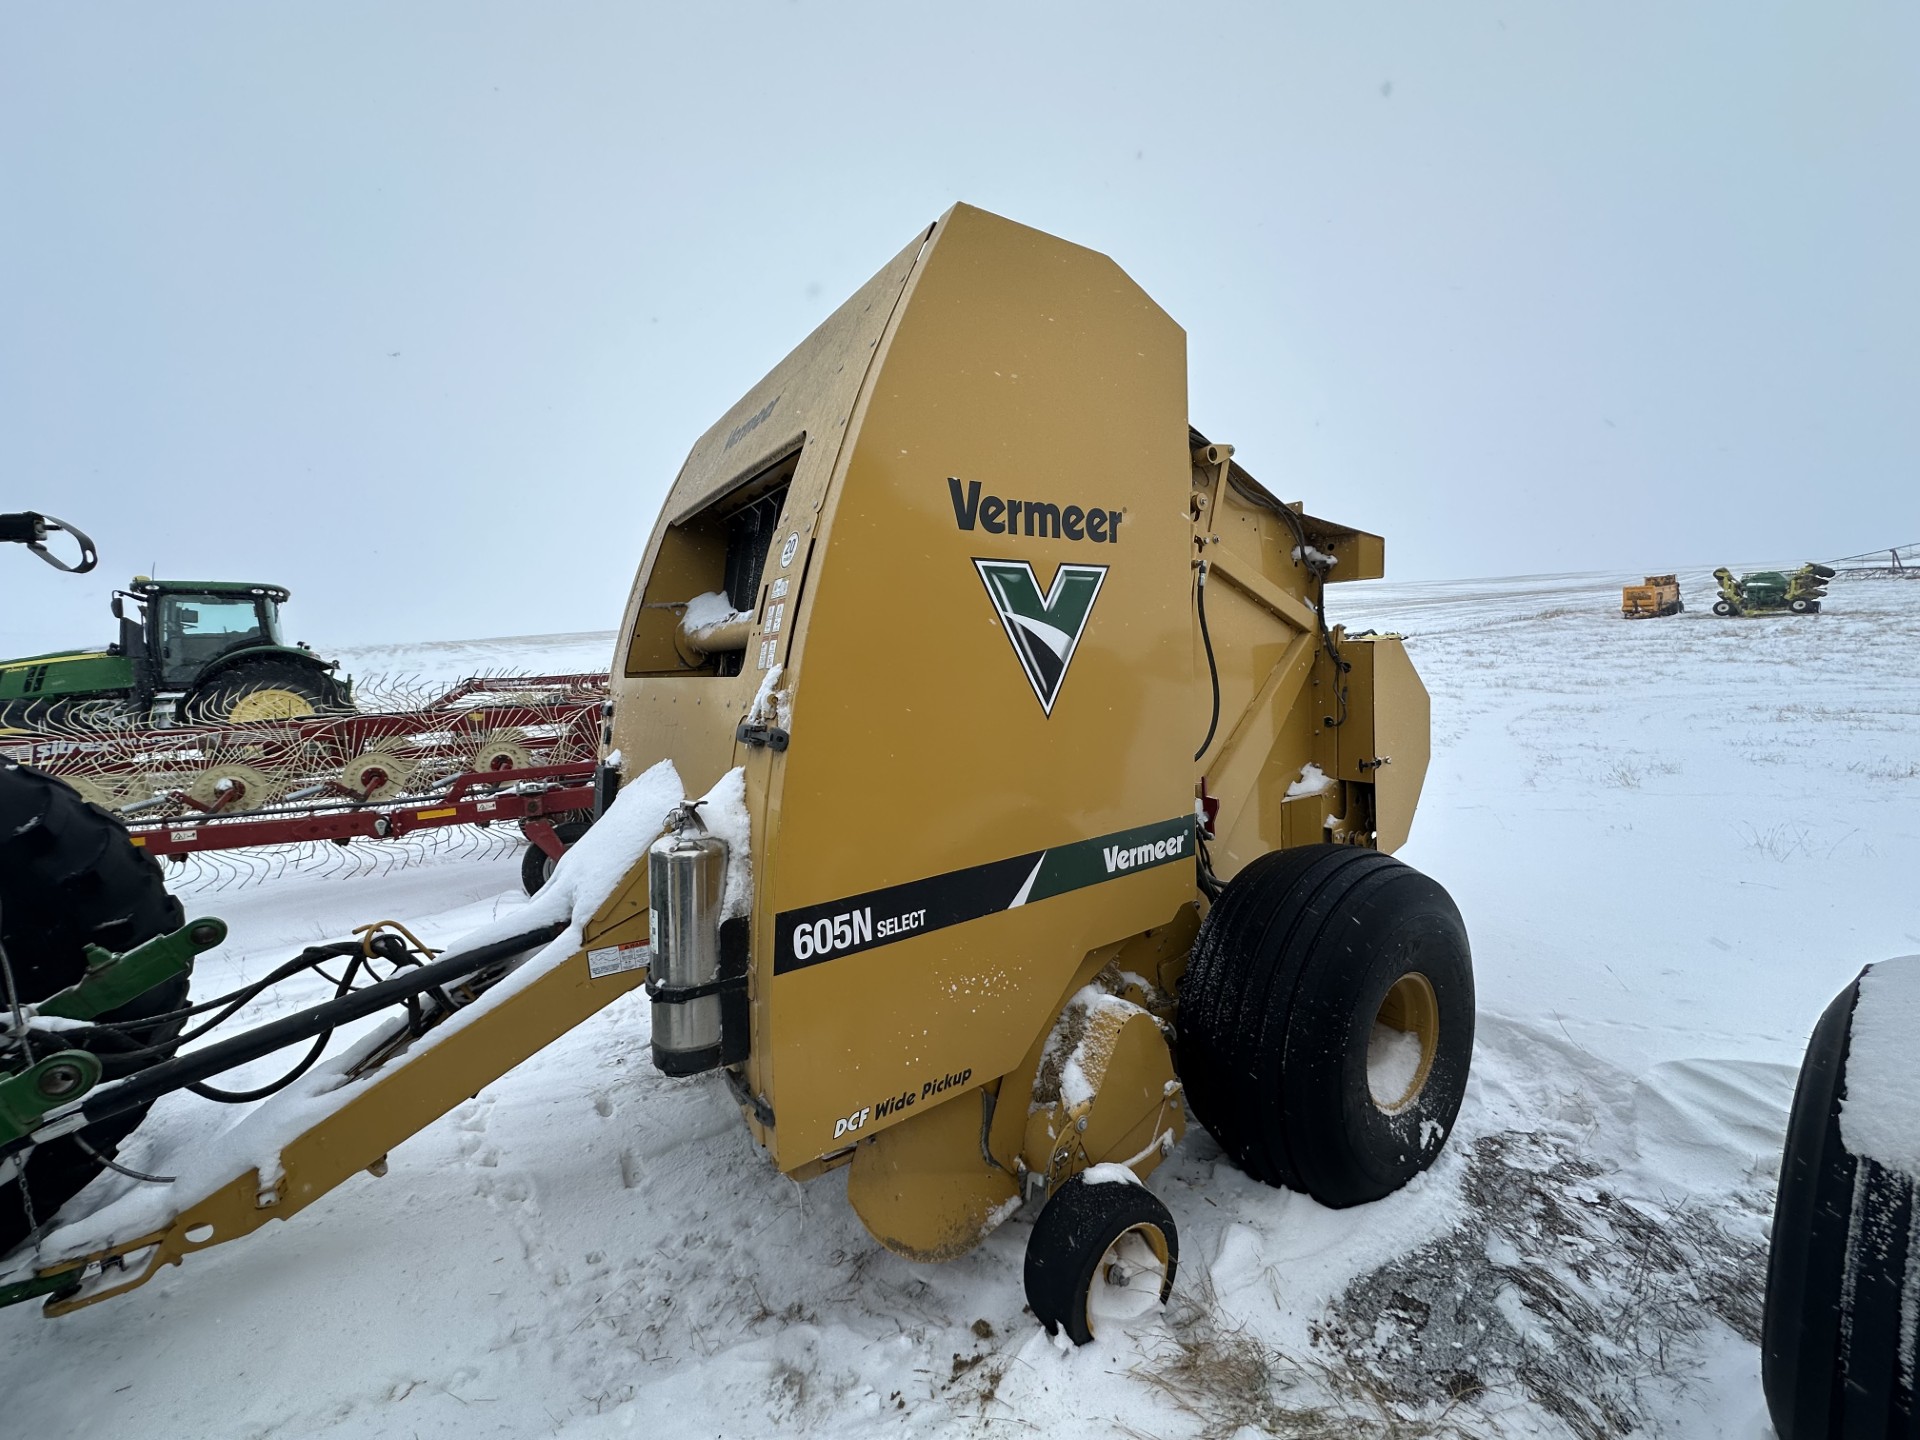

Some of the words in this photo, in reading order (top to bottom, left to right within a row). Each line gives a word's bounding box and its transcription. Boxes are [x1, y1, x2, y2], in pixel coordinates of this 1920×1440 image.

[947, 477, 1122, 543] Vermeer
[784, 538, 797, 555] 20
[1103, 834, 1184, 873] Vermeer
[793, 907, 873, 960] 605N
[876, 909, 926, 938] SELECT
[832, 1106, 871, 1140] DCF
[874, 1091, 916, 1120] Wide
[921, 1068, 972, 1100] Pickup
